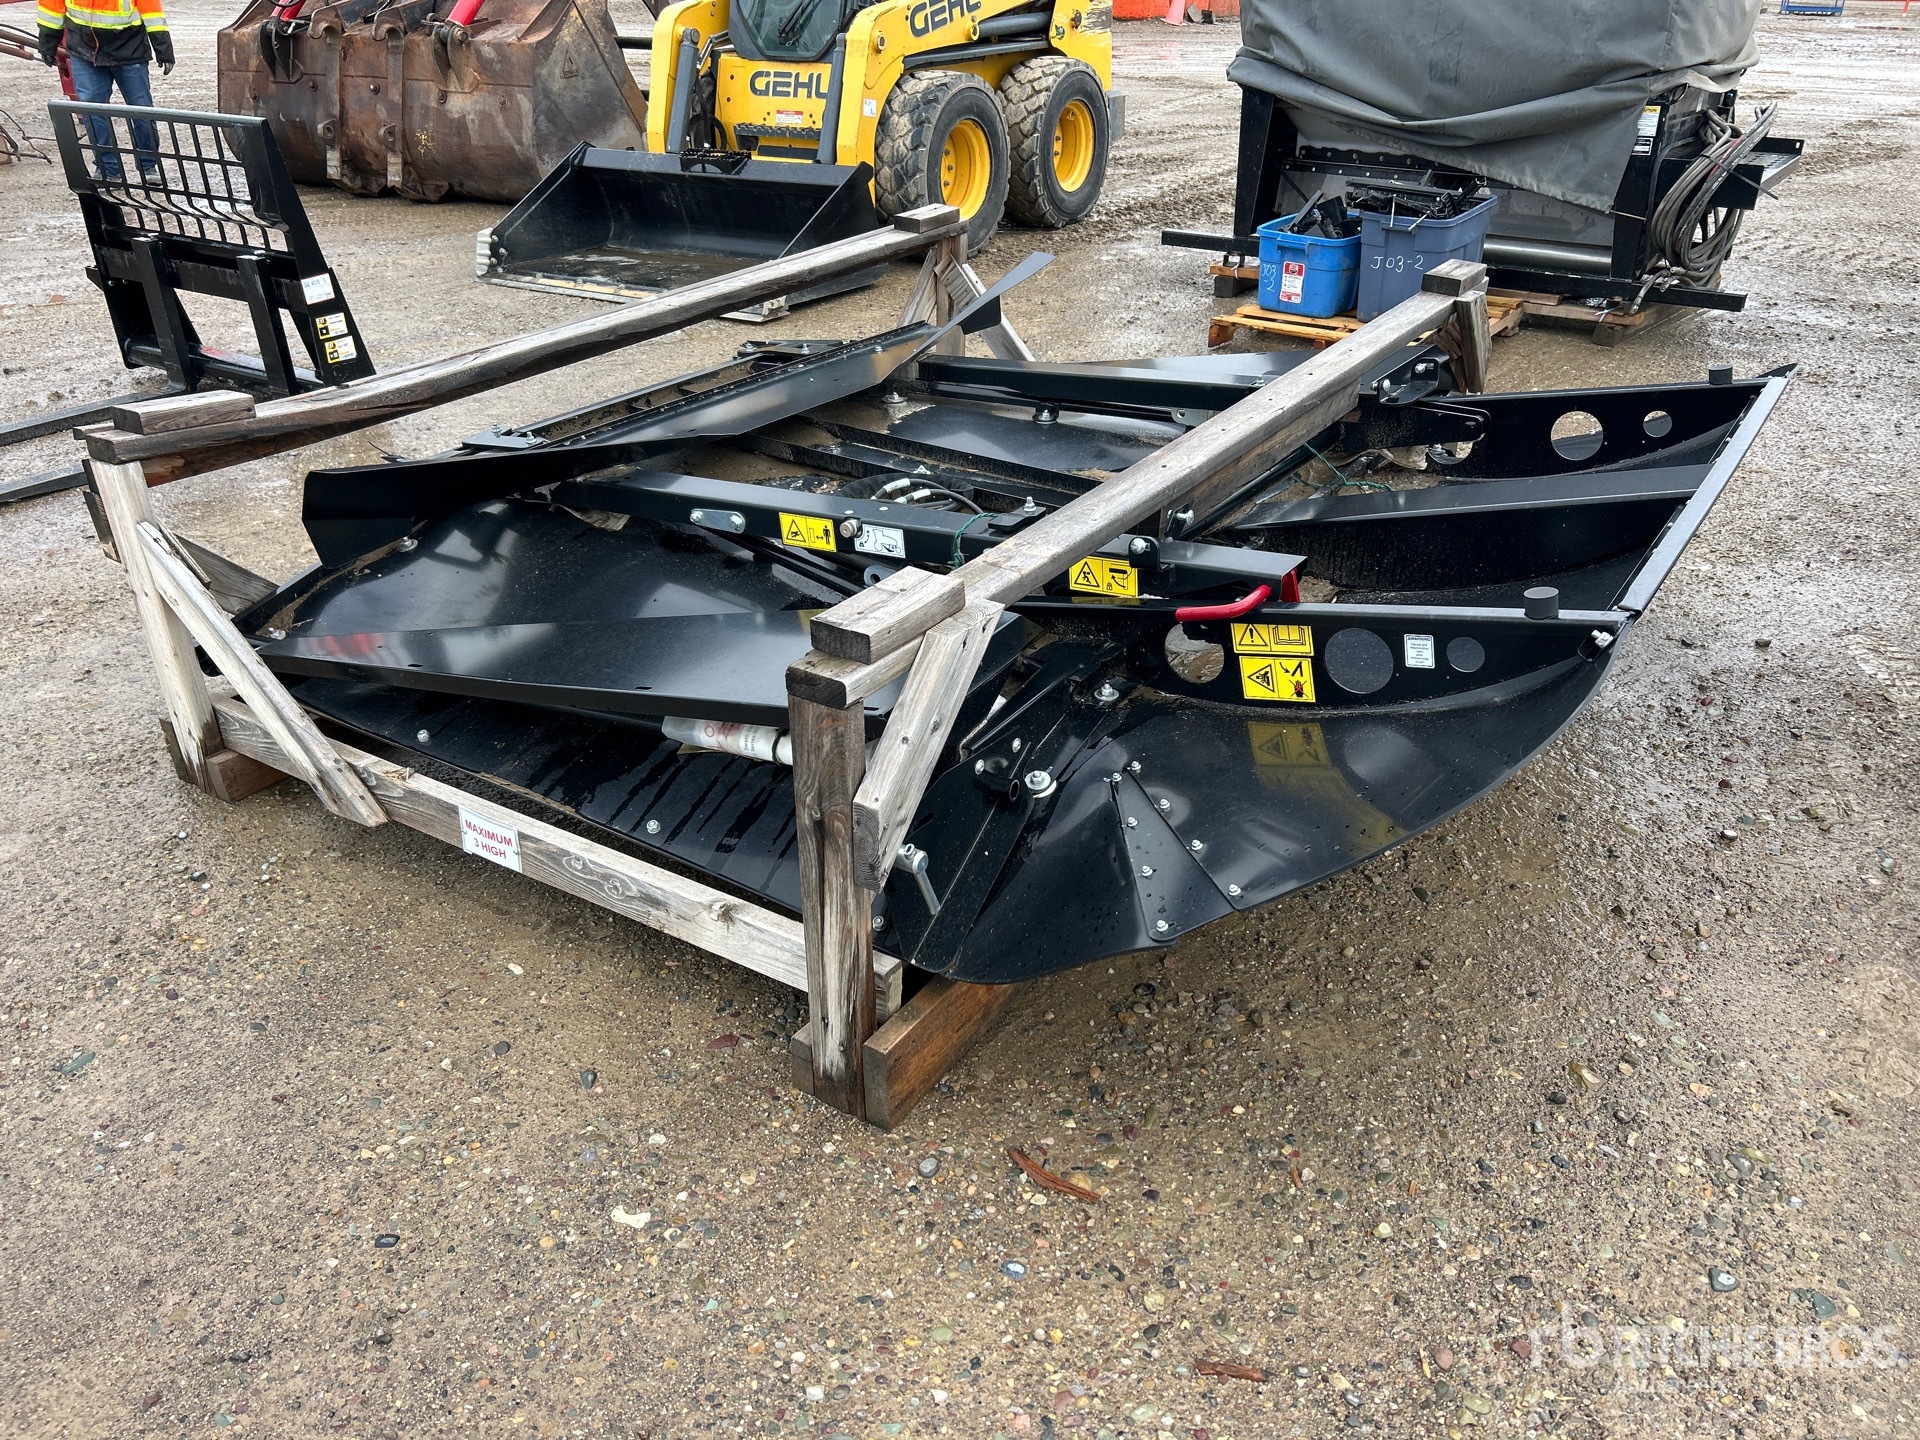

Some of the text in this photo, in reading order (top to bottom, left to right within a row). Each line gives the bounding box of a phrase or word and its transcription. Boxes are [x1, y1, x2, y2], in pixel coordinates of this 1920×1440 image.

[749, 71, 829, 99] GEHL
[465, 819, 513, 847] MAXIMUM
[474, 838, 507, 859] 3 HIGH
